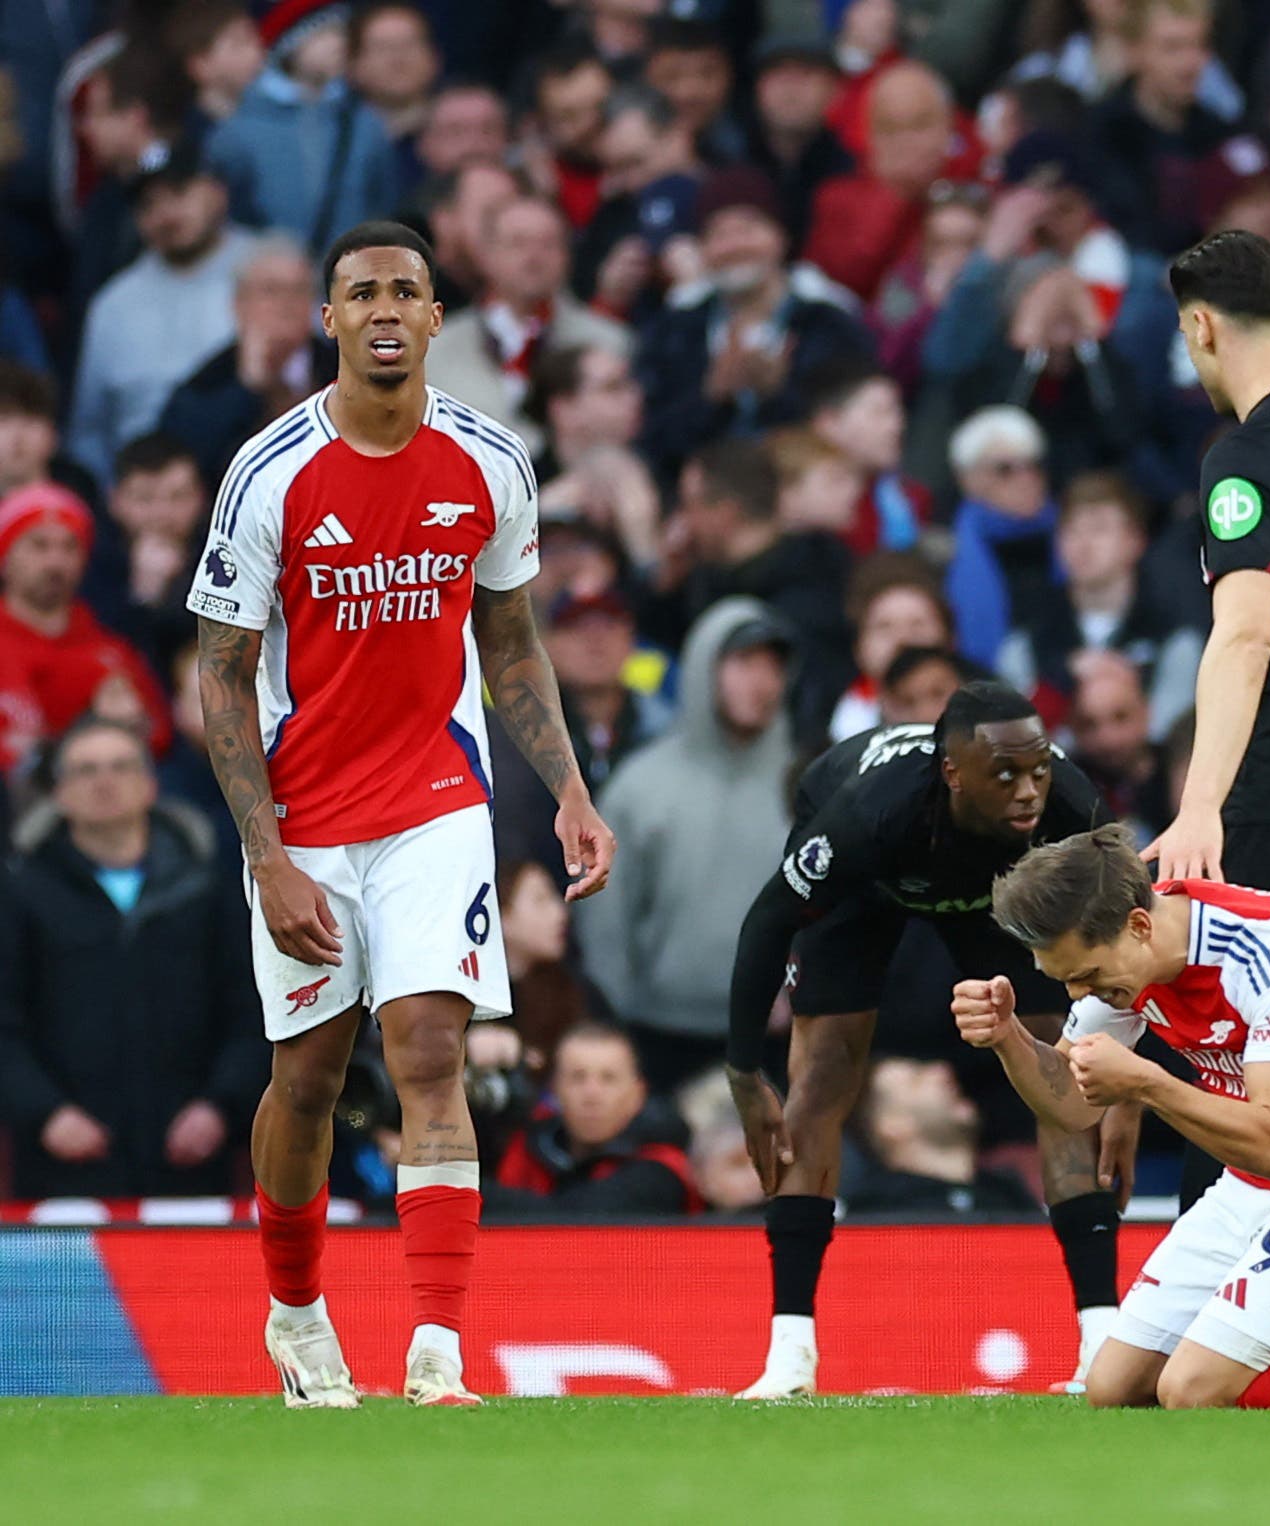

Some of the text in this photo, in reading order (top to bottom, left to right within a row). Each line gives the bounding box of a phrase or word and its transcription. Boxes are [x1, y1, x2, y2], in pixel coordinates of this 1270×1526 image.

[304, 548, 469, 599] Emirates
[335, 600, 373, 632] FLY
[465, 882, 491, 945] 6
